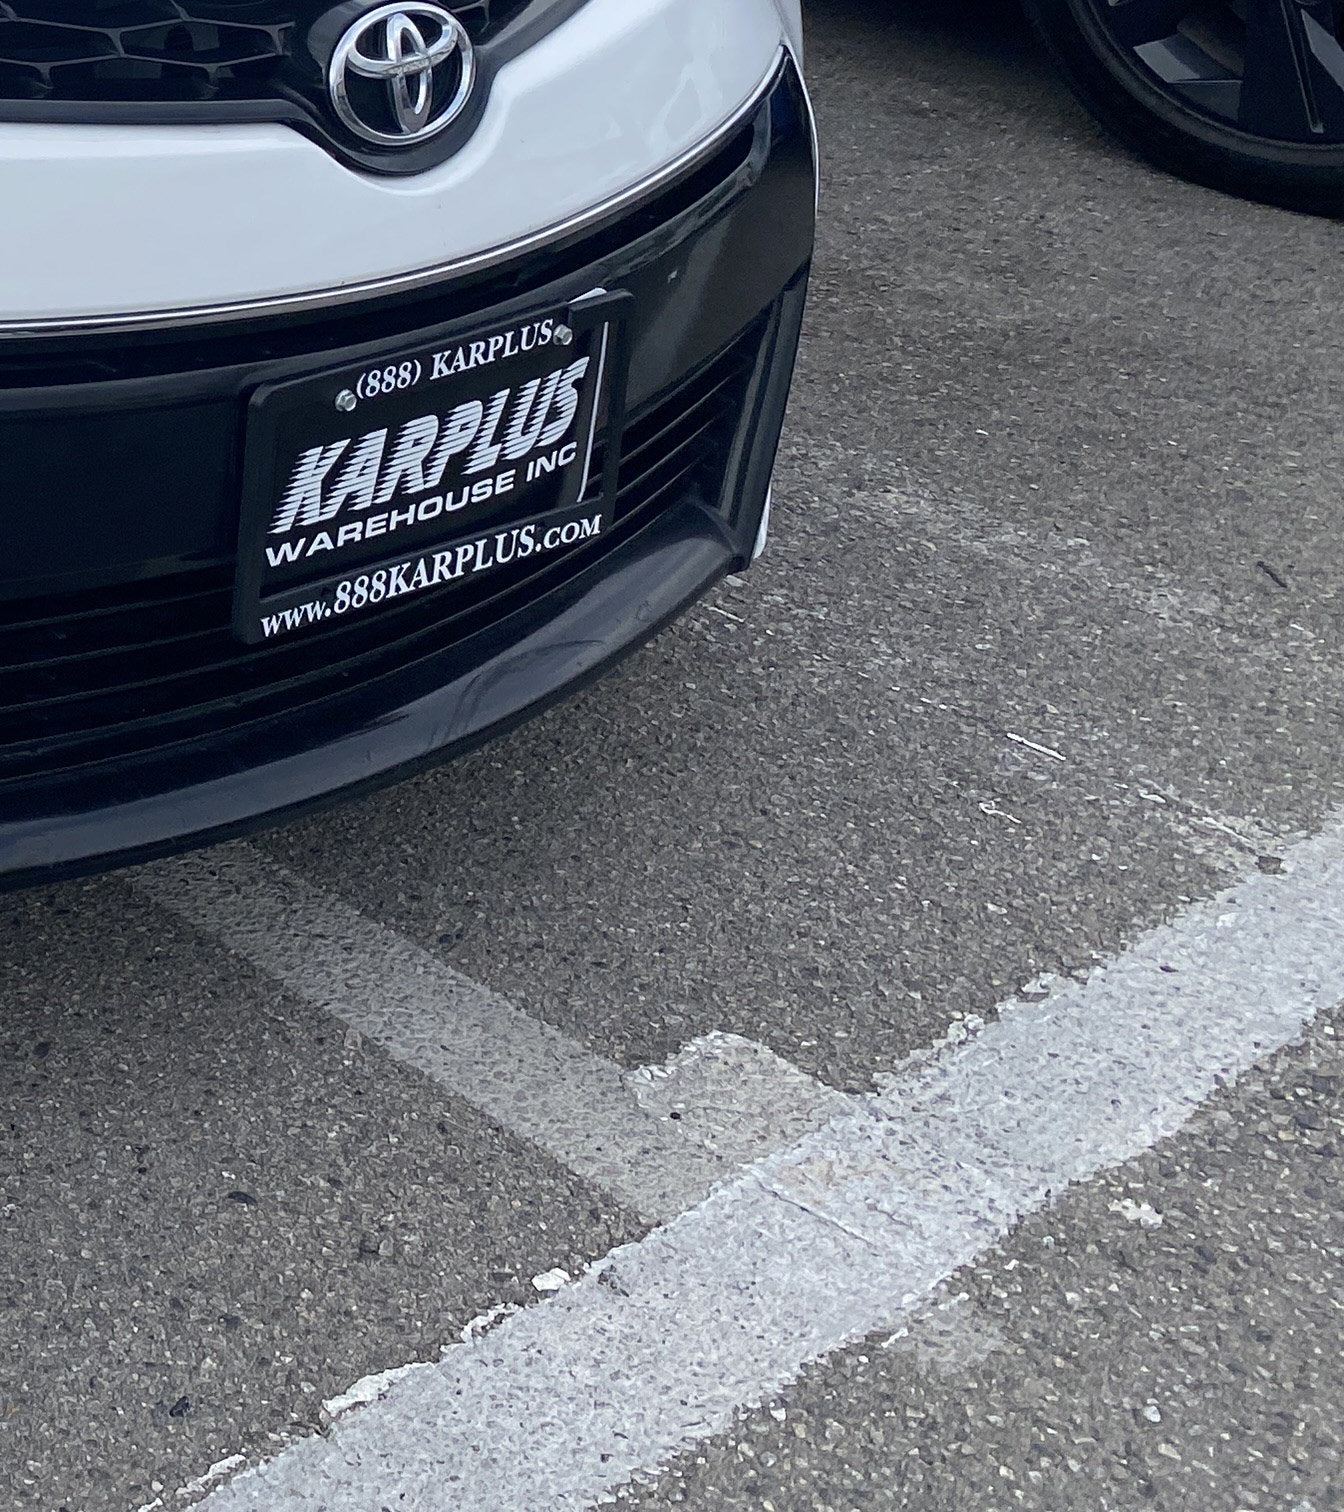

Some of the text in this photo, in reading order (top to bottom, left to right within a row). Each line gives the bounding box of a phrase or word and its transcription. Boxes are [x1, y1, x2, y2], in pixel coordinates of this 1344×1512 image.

[356, 319, 554, 400] (888) KARPLUS
[265, 442, 578, 567] WAREHOUSE INC
[266, 356, 590, 535] KARPLUS
[260, 514, 602, 637] www.888KARPLUS.COM
